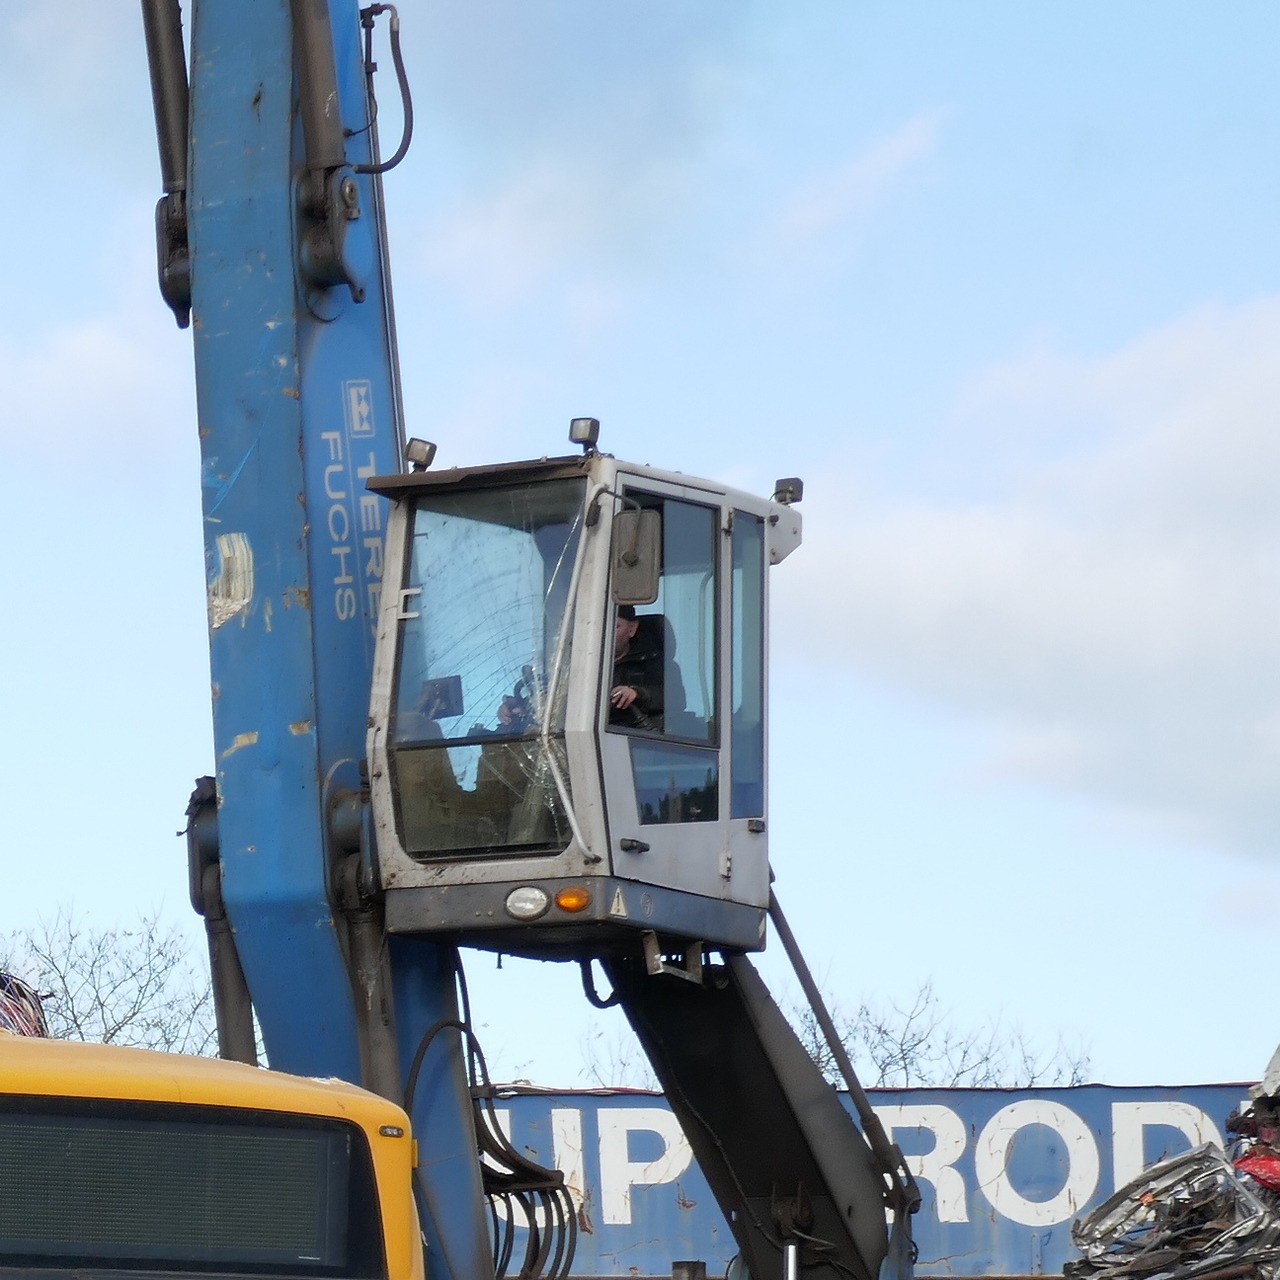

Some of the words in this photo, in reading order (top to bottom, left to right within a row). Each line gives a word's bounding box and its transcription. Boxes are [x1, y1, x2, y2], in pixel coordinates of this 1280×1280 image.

[321, 431, 356, 621] FUCHS
[357, 451, 388, 640] TERE
[862, 1100, 1258, 1228] ROD
